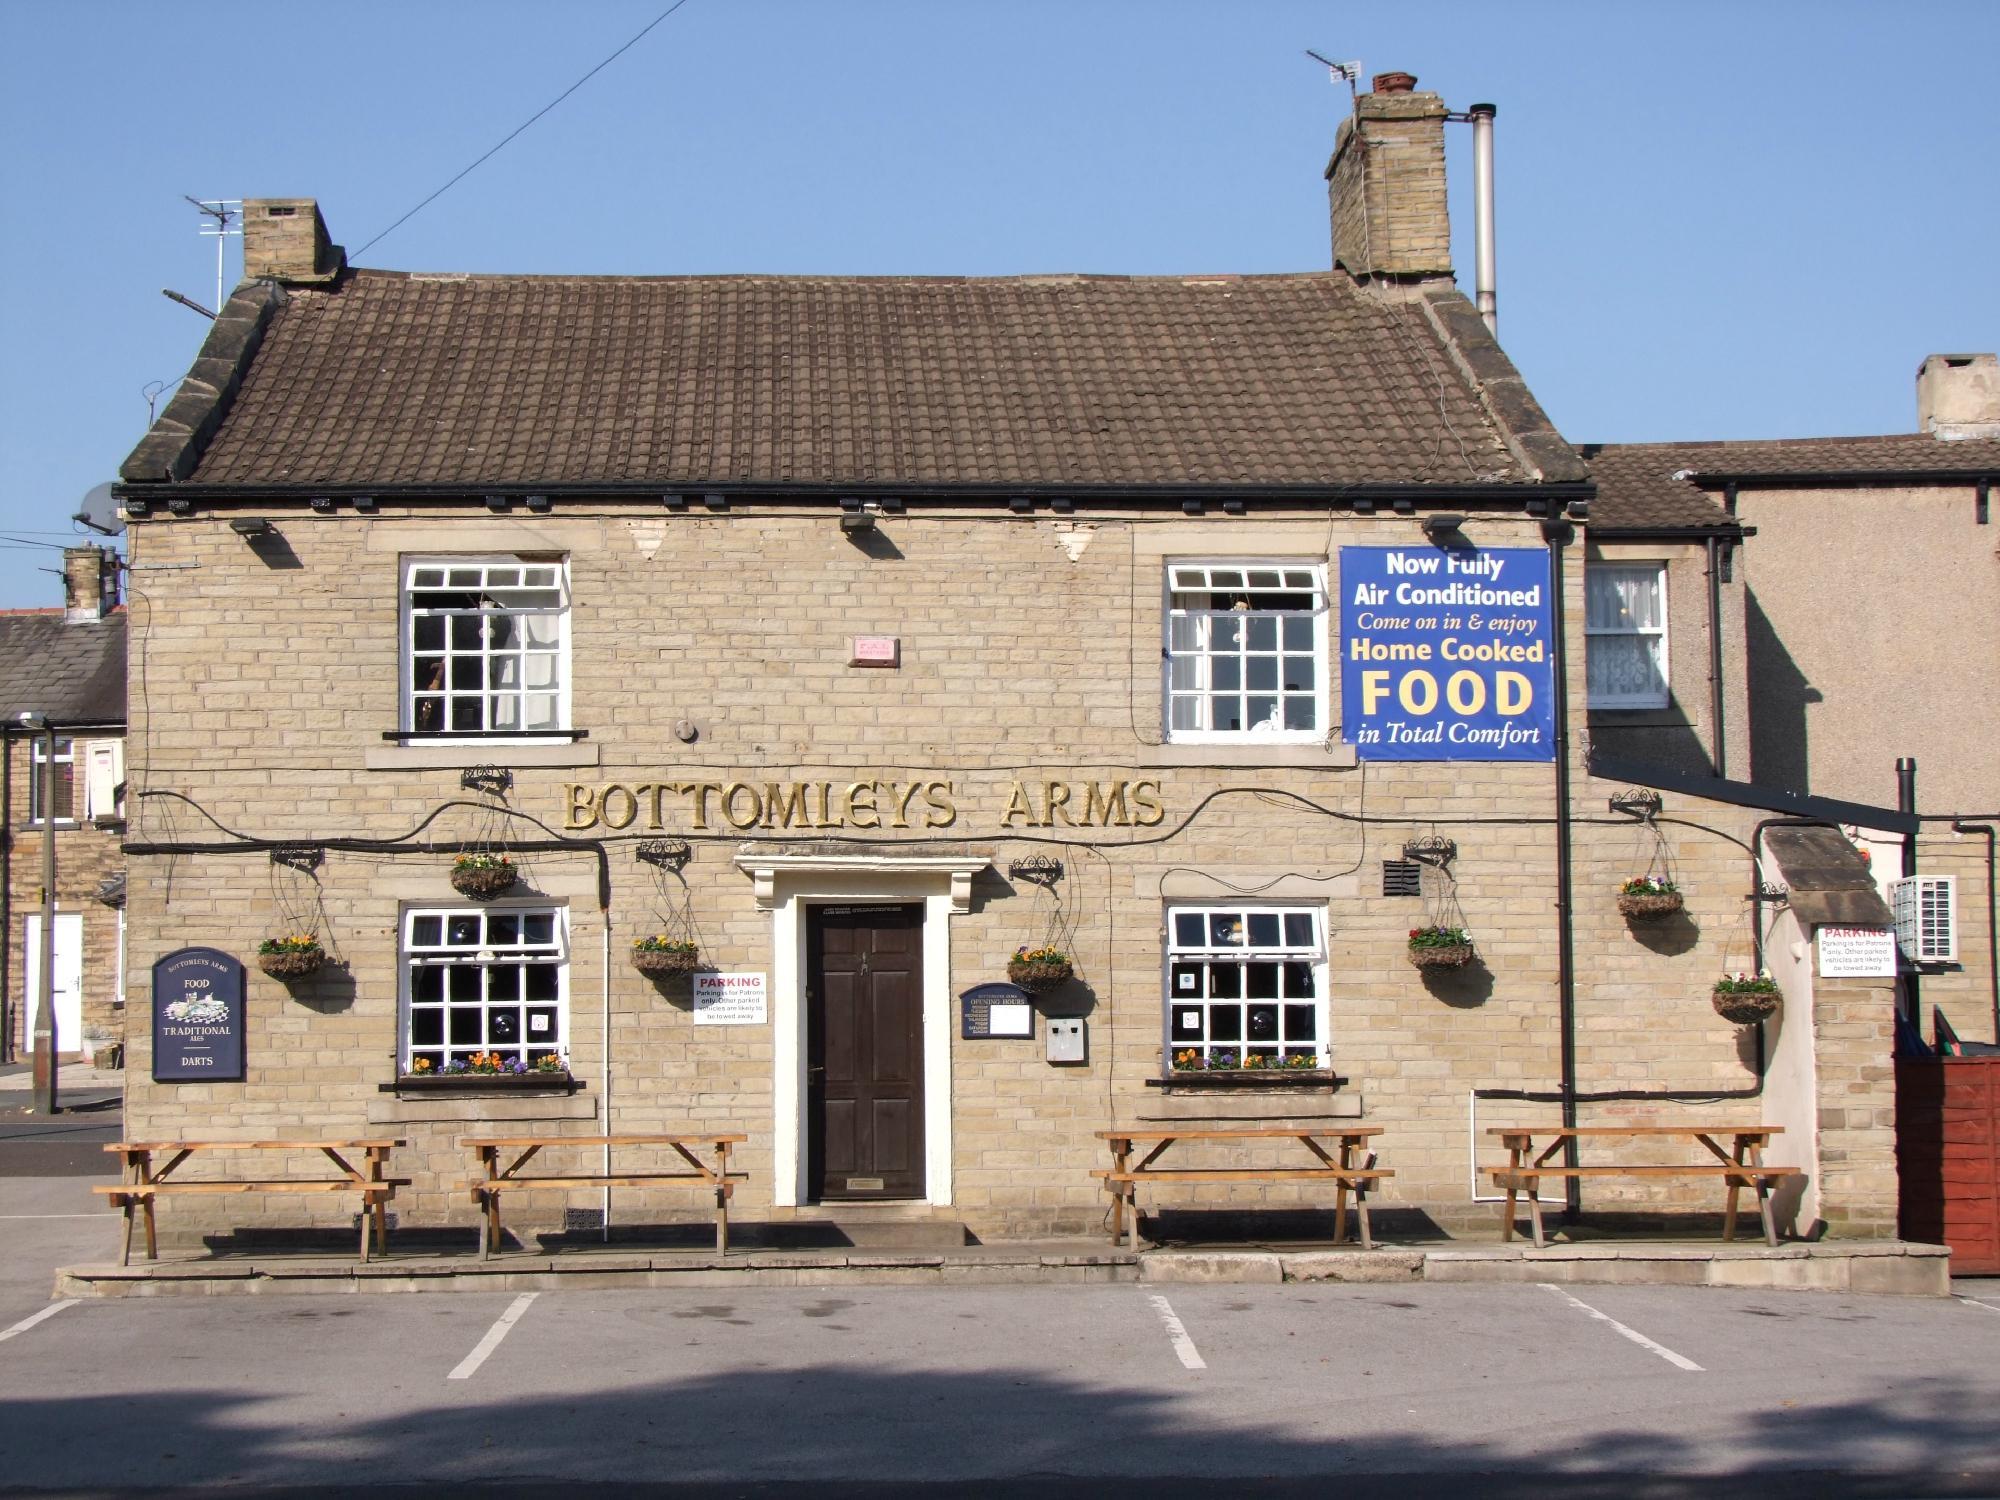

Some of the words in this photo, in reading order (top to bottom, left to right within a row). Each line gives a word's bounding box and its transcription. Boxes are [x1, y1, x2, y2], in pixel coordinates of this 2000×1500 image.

[1386, 553, 1440, 575] Now
[1447, 553, 1505, 581] Fully
[1354, 583, 1390, 606] Air
[1396, 582, 1540, 607] Conditioned
[1357, 612, 1410, 630] Come
[1415, 617, 1438, 630] on
[1443, 613, 1462, 630] in
[1468, 613, 1484, 630] &
[1488, 614, 1537, 636] enjoy
[1350, 638, 1433, 661] Home
[1440, 637, 1544, 663] Cooked
[1361, 669, 1534, 716] FOOD
[1357, 725, 1381, 743] in
[1386, 721, 1444, 744] Total
[1449, 721, 1541, 749] Comfort
[563, 779, 957, 831] BOTTOMLEYS
[1000, 779, 1165, 828] ARMS
[1824, 927, 1887, 938] PARKING
[1822, 940, 1847, 948] Parking
[210, 959, 229, 973] ARMS
[184, 979, 210, 989] FOOD
[700, 978, 761, 988] PARKING
[163, 1026, 232, 1036] TRADITIONAL
[182, 1057, 213, 1066] DARTS
